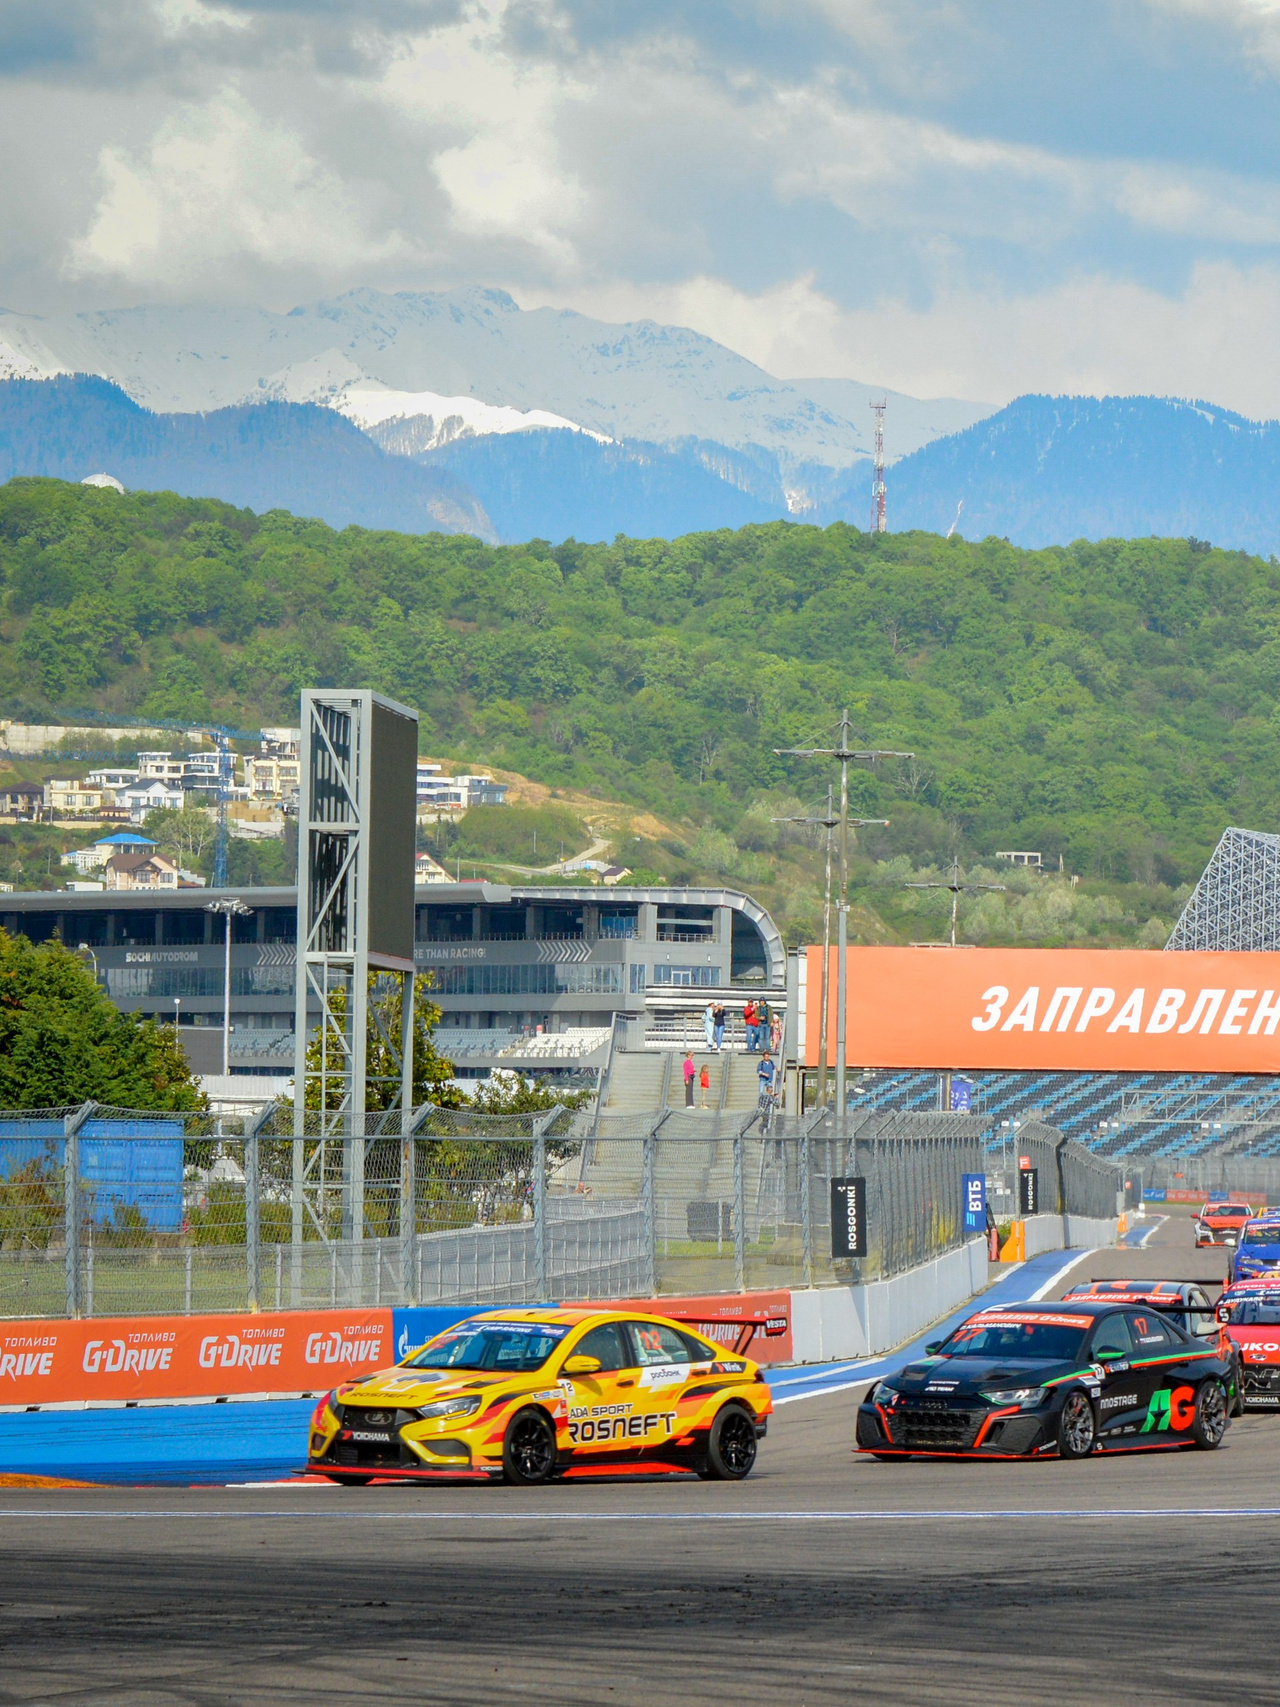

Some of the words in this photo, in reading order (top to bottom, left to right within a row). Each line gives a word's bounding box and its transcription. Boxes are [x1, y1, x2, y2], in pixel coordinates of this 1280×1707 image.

[425, 949, 449, 960] THAN
[450, 947, 487, 959] RACING!
[969, 1180, 982, 1212] ВТБ
[847, 1185, 857, 1250] ROSGONKI
[973, 1312, 1039, 1322] ЗАПРАВЛЕНО
[343, 1324, 384, 1335] ТОПЛИВО
[766, 1319, 787, 1329] VESTA
[1134, 1317, 1149, 1336] 17
[128, 1332, 176, 1343] ТОПЛИВО
[242, 1327, 286, 1339] ТОПЛИВО
[951, 1328, 985, 1343] 17
[5, 1336, 57, 1347] ТОПЛИВО
[640, 1329, 663, 1350] 12
[0, 1349, 54, 1382] RIVE
[723, 1362, 742, 1372] Wink
[350, 1392, 419, 1400] ROSNEFT
[1245, 1396, 1280, 1404] YOKOHAMA
[590, 1403, 634, 1417] SPORT
[568, 1411, 677, 1445] ROSNEFT
[352, 1431, 390, 1442] YOKOHAMA
